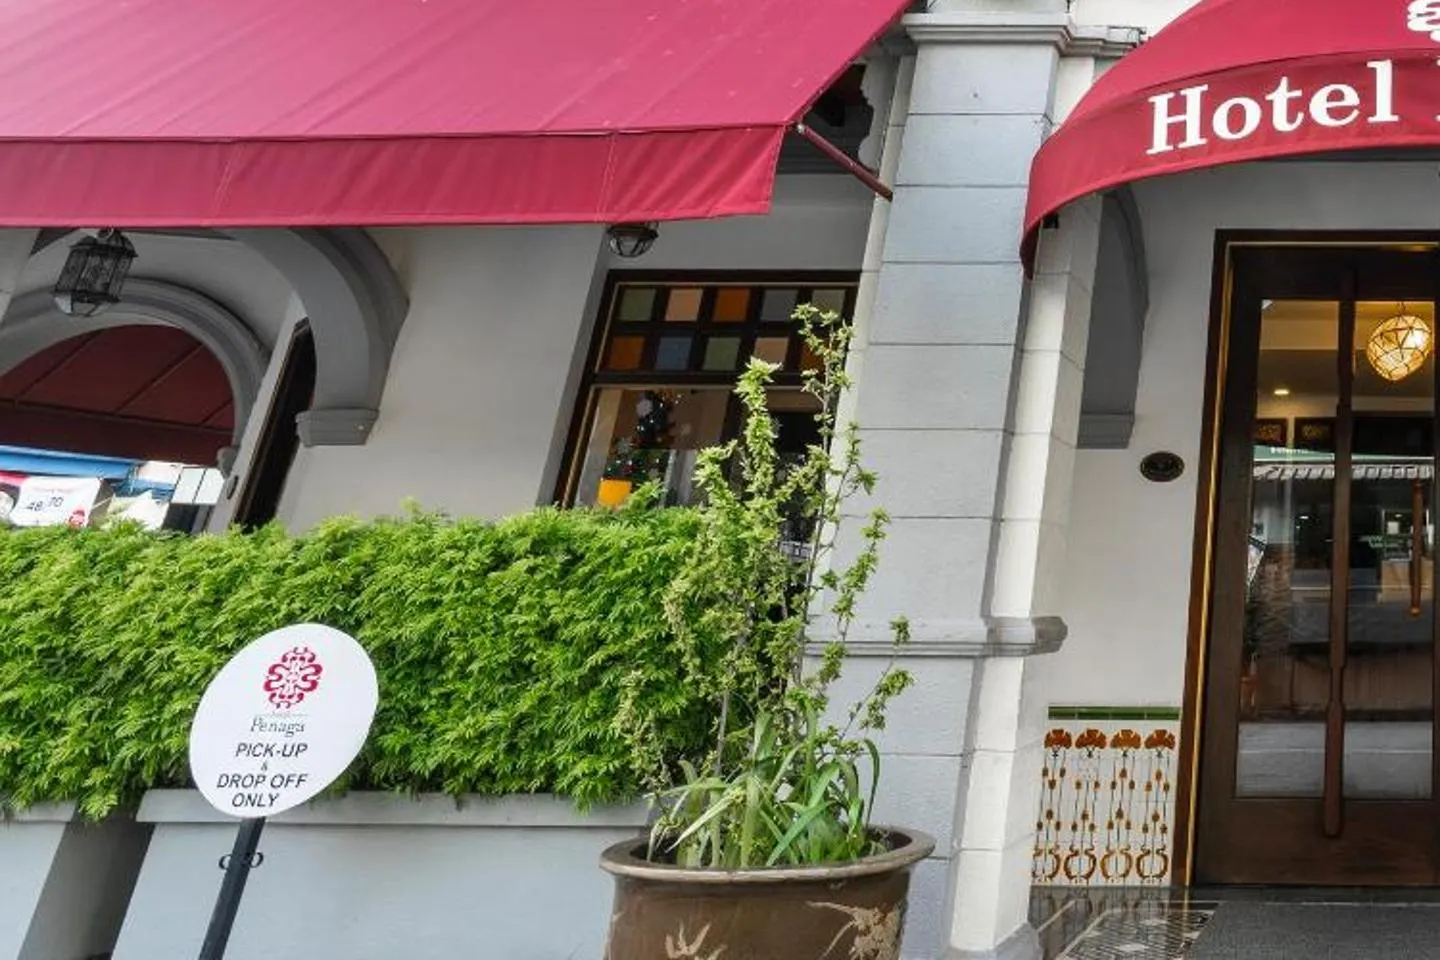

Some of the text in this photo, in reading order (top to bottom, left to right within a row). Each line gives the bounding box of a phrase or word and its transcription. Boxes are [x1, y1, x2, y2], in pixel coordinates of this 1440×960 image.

[1146, 59, 1400, 155] Hotel
[250, 716, 306, 738] Penaga
[235, 742, 309, 758] PICK-UP
[216, 772, 309, 789] DROP OFF
[231, 792, 280, 807] ONLY
